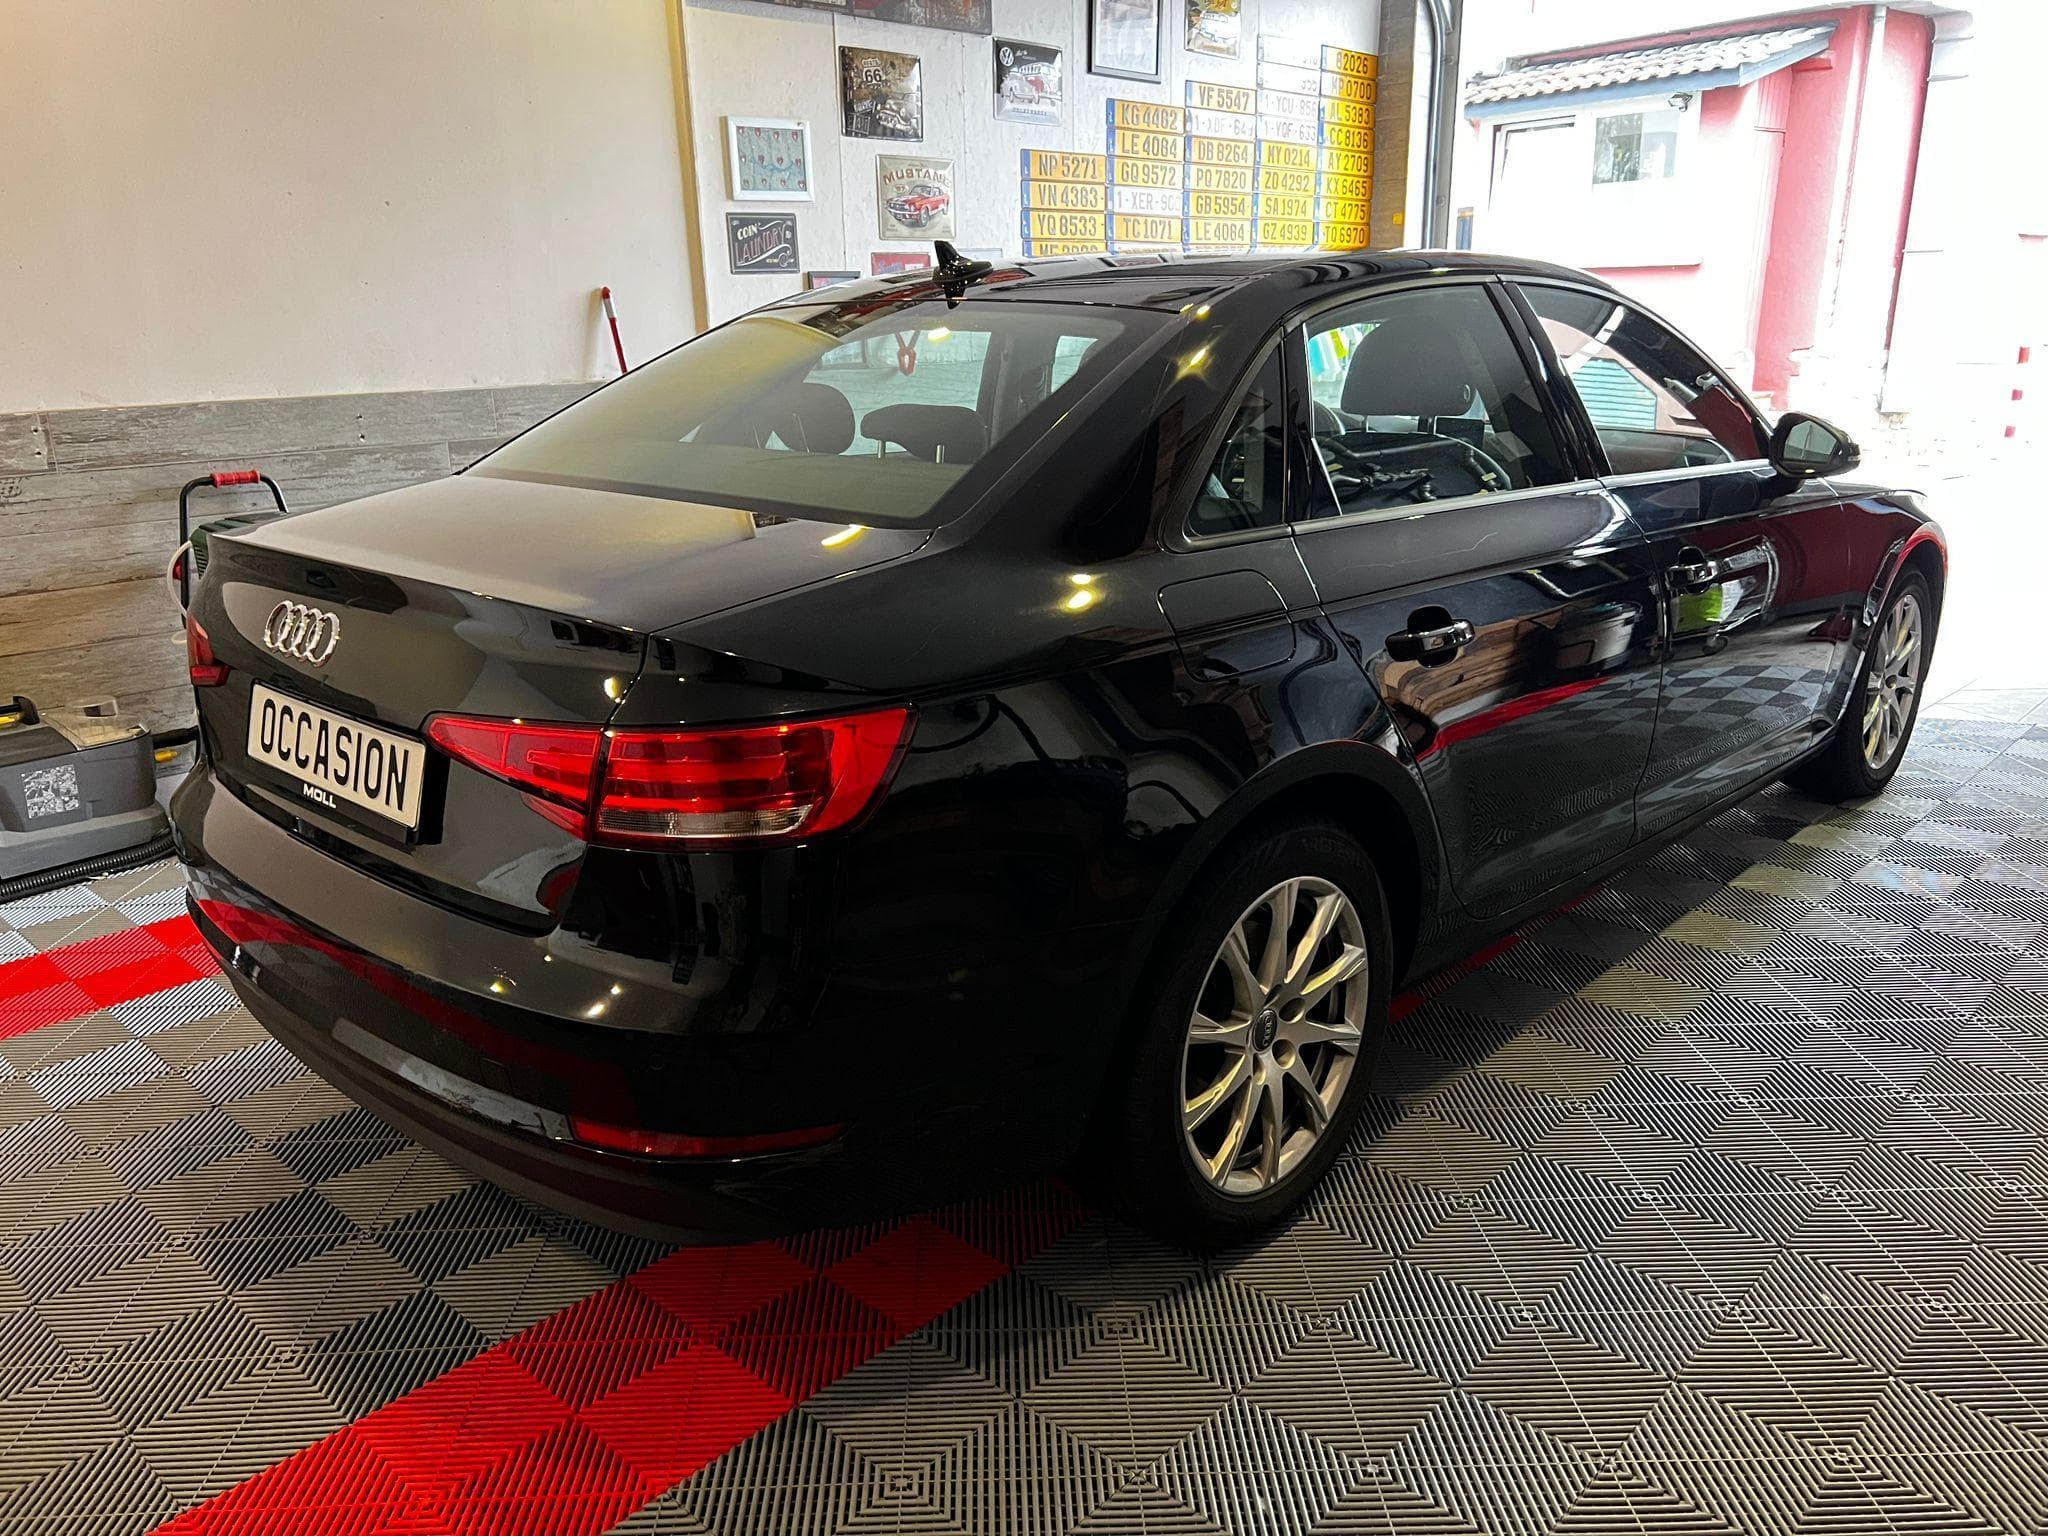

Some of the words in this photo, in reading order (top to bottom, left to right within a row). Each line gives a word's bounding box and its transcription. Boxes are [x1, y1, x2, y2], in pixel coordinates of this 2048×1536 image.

[864, 68, 882, 83] 66
[1199, 85, 1215, 107] VF
[1217, 88, 1249, 111] 5547
[1346, 80, 1372, 100] 0700
[1122, 103, 1140, 126] KG
[1330, 102, 1343, 120] AL
[1345, 105, 1370, 125] 5383
[1122, 132, 1140, 154] LE
[1329, 127, 1343, 146] CC
[1345, 129, 1368, 149] 8136
[1199, 141, 1214, 160] DB
[1217, 142, 1248, 163] 8264
[1285, 147, 1310, 167] 0214
[1328, 152, 1341, 170] AY
[1343, 154, 1369, 173] 2709
[1039, 154, 1057, 176] NP
[1061, 156, 1097, 179] 5271
[1121, 161, 1139, 183] GQ
[1142, 163, 1176, 186] 9572
[1197, 168, 1212, 187] PQ
[1216, 169, 1246, 189] 7820
[1281, 172, 1310, 192] 4292
[1326, 176, 1339, 195] KX
[1341, 178, 1367, 197] 6465
[1038, 184, 1057, 206] VN
[1196, 195, 1212, 214] GB
[1214, 196, 1245, 215] 5954
[1265, 197, 1279, 215] SA
[1281, 198, 1307, 217] 1974
[1325, 201, 1339, 218] CT
[1341, 203, 1366, 221] 4775
[737, 223, 758, 240] COIN
[1038, 214, 1056, 235] YQ
[1060, 215, 1097, 236] 8533
[1123, 217, 1140, 238] TC
[1143, 218, 1173, 240] 1071
[1196, 221, 1211, 241] LE
[1263, 222, 1277, 240] GZ
[1280, 223, 1307, 241] 4939
[1340, 226, 1365, 244] 6970
[735, 223, 786, 264] LAUNDRY
[260, 698, 410, 812] OCCASION
[303, 783, 337, 809] MOLL
